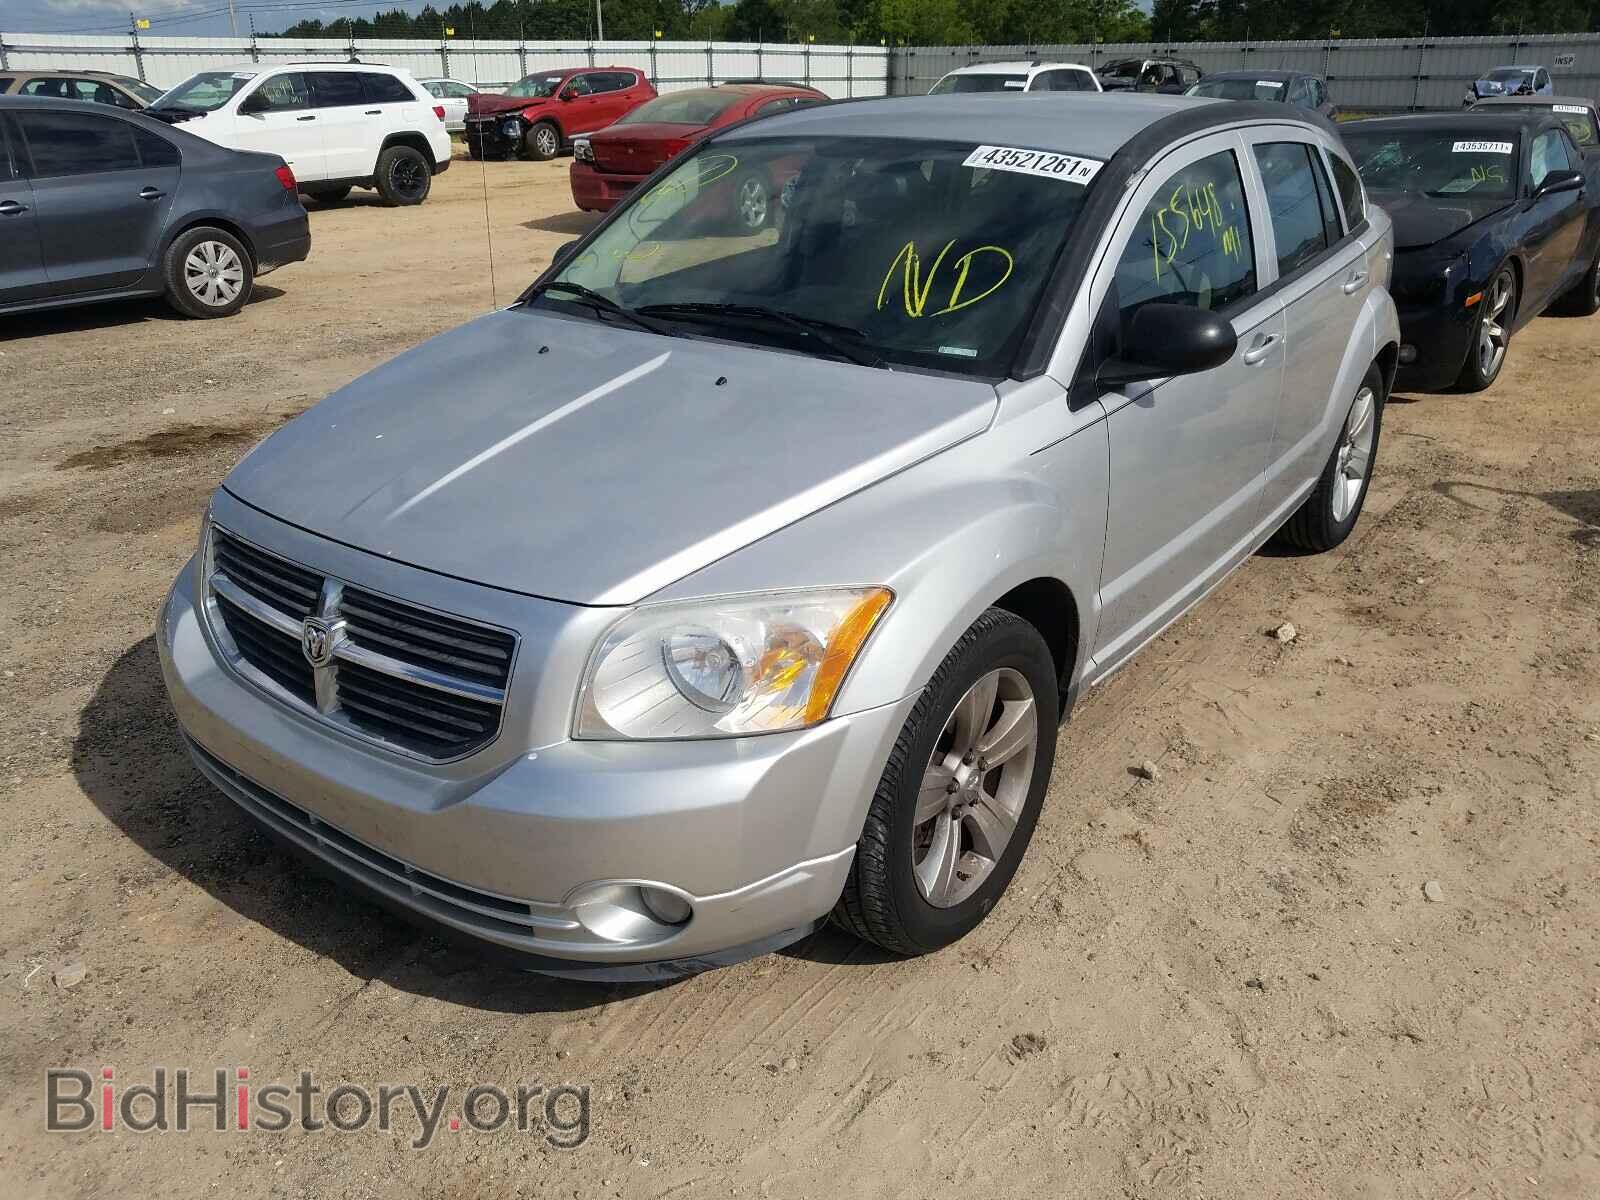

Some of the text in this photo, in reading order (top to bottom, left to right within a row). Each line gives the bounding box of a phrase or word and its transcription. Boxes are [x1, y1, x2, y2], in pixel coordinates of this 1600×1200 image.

[983, 148, 1082, 176] 43521261
[1078, 166, 1092, 177] N
[877, 239, 1013, 318] ND
